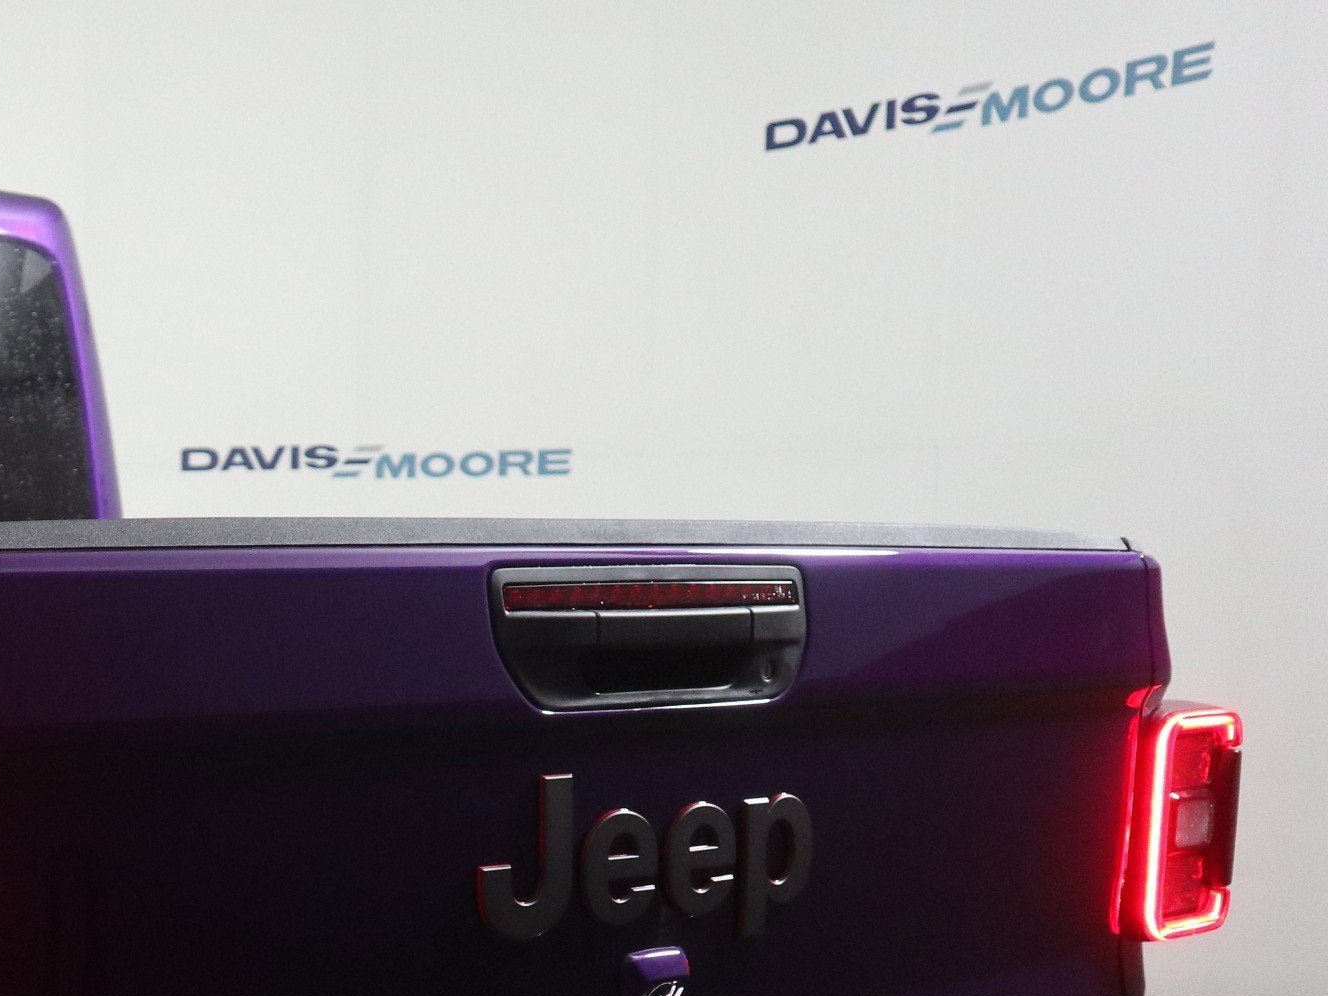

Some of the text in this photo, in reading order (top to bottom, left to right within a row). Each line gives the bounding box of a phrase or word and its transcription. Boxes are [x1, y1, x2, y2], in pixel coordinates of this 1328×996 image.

[764, 40, 1216, 152] DAVIS MOORE
[180, 445, 573, 479] DAVIS MOORE
[475, 772, 814, 940] Jeep
